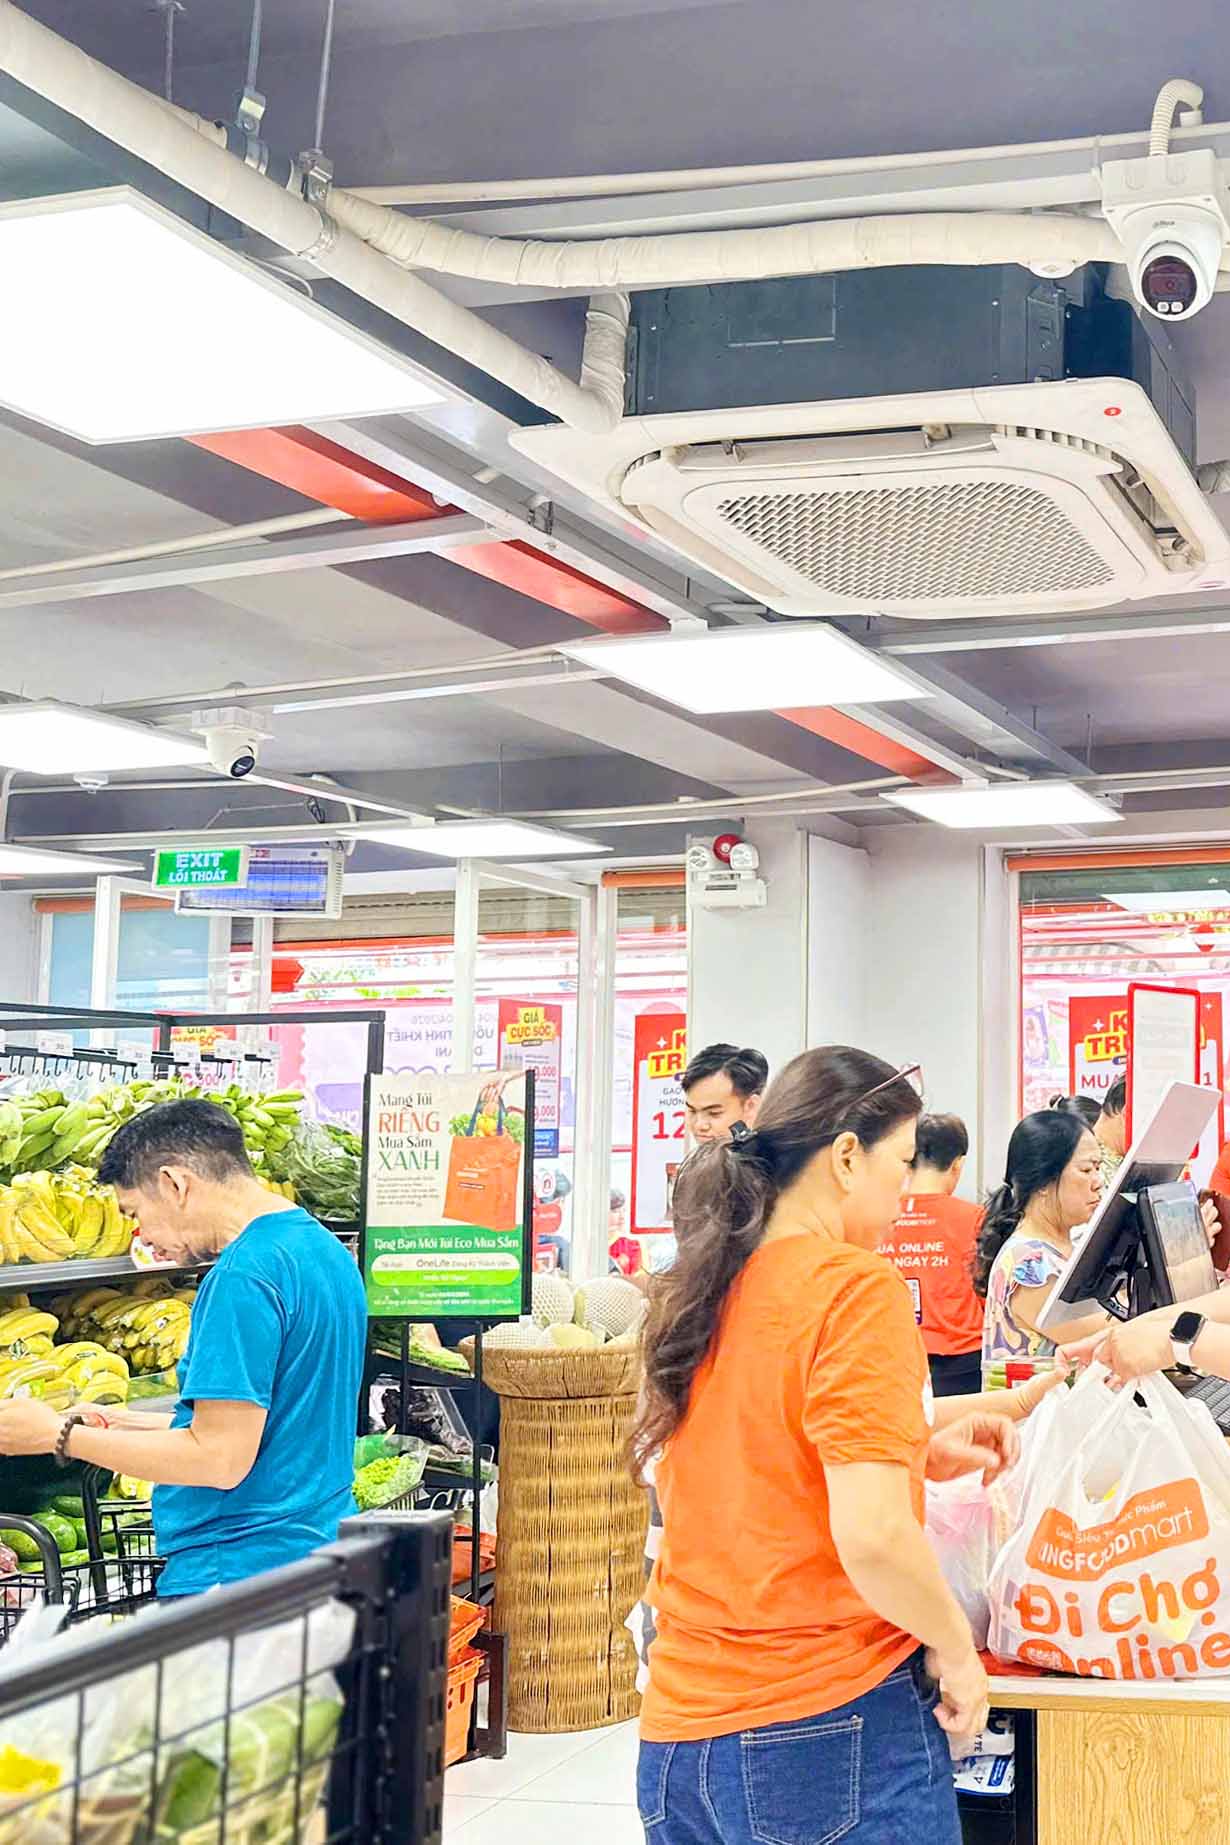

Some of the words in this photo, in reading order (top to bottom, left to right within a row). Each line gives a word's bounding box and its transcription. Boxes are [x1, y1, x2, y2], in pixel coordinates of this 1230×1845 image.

[175, 852, 224, 868] EXIT
[191, 868, 229, 882] THOÁT
[379, 1093, 413, 1107] Mang
[416, 1092, 432, 1105] Túi
[378, 1107, 440, 1134] RIÊNG
[378, 1137, 403, 1149] Mua
[378, 1151, 440, 1171] XANH
[374, 1238, 396, 1250] Tặng
[455, 1238, 472, 1248] Eco
[474, 1238, 495, 1248] Mua
[899, 1241, 945, 1253] ONLINE
[931, 1255, 949, 1267] 2H
[1014, 1583, 1083, 1638] Đi
[1097, 1557, 1220, 1633] Chợ
